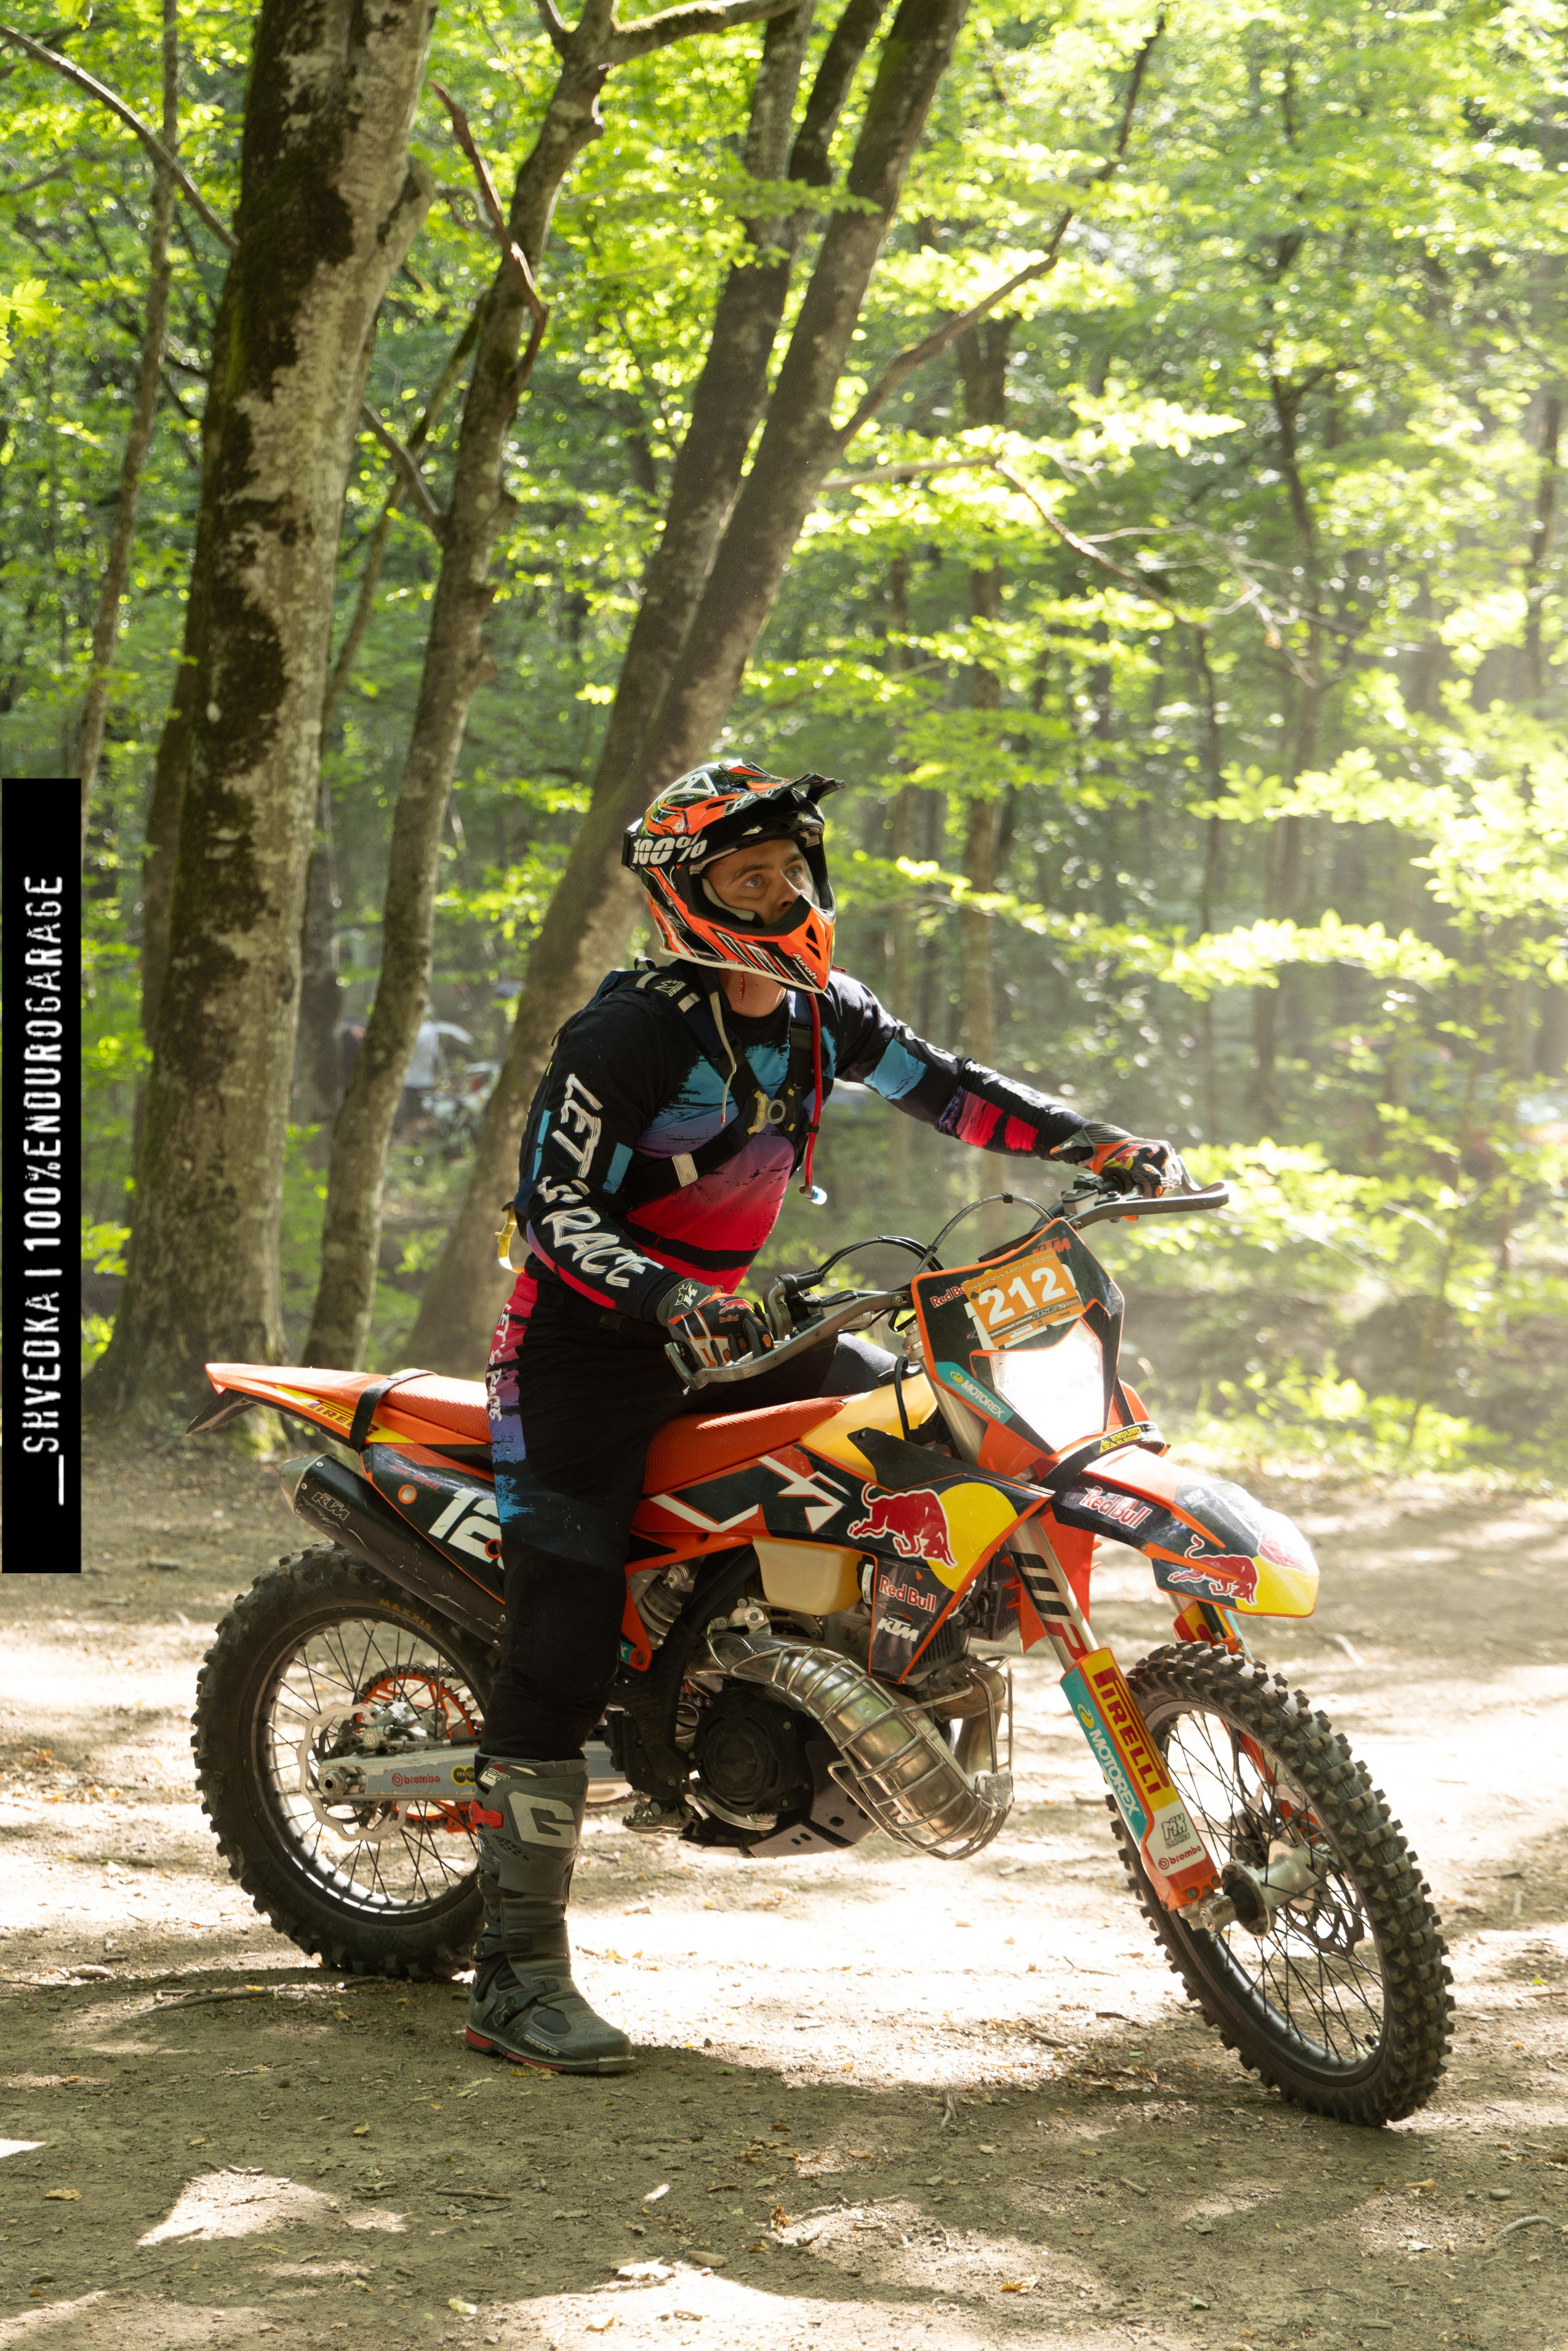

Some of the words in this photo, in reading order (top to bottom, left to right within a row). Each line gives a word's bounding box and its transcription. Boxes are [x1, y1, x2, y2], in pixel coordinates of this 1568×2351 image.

[632, 829, 707, 865] 100%
[792, 953, 818, 980] Airoh
[668, 982, 685, 997] USWE
[542, 1207, 663, 1288] RACE
[967, 1271, 1005, 1291] НОВОРОСС
[1005, 1252, 1054, 1275] КАНТРИ-КРОСС
[930, 1289, 953, 1308] Red
[952, 1285, 967, 1300] Bu
[978, 1267, 1066, 1326] 212
[989, 1323, 1016, 1338] ГЕНЕРАЛЬНЫЙ
[1016, 1315, 1033, 1326] СПОНСОР
[960, 1380, 1006, 1419] MOTOREX
[307, 1400, 380, 1437] PIREI
[1110, 1426, 1142, 1441] ENDURO
[311, 1492, 350, 1521] KTM
[1079, 1485, 1112, 1515] Red
[1109, 1495, 1153, 1529] Bull
[428, 1487, 505, 1571] 12
[879, 1575, 907, 1602] Red
[907, 1588, 936, 1613] Bull
[379, 1598, 432, 1631] MAXXIS
[876, 1616, 919, 1642] KTM
[1093, 1666, 1170, 1795] PIRELLI
[404, 1773, 440, 1784] brembo
[1088, 1727, 1141, 1817] MOTOREX
[1169, 1845, 1202, 1865] brembo
